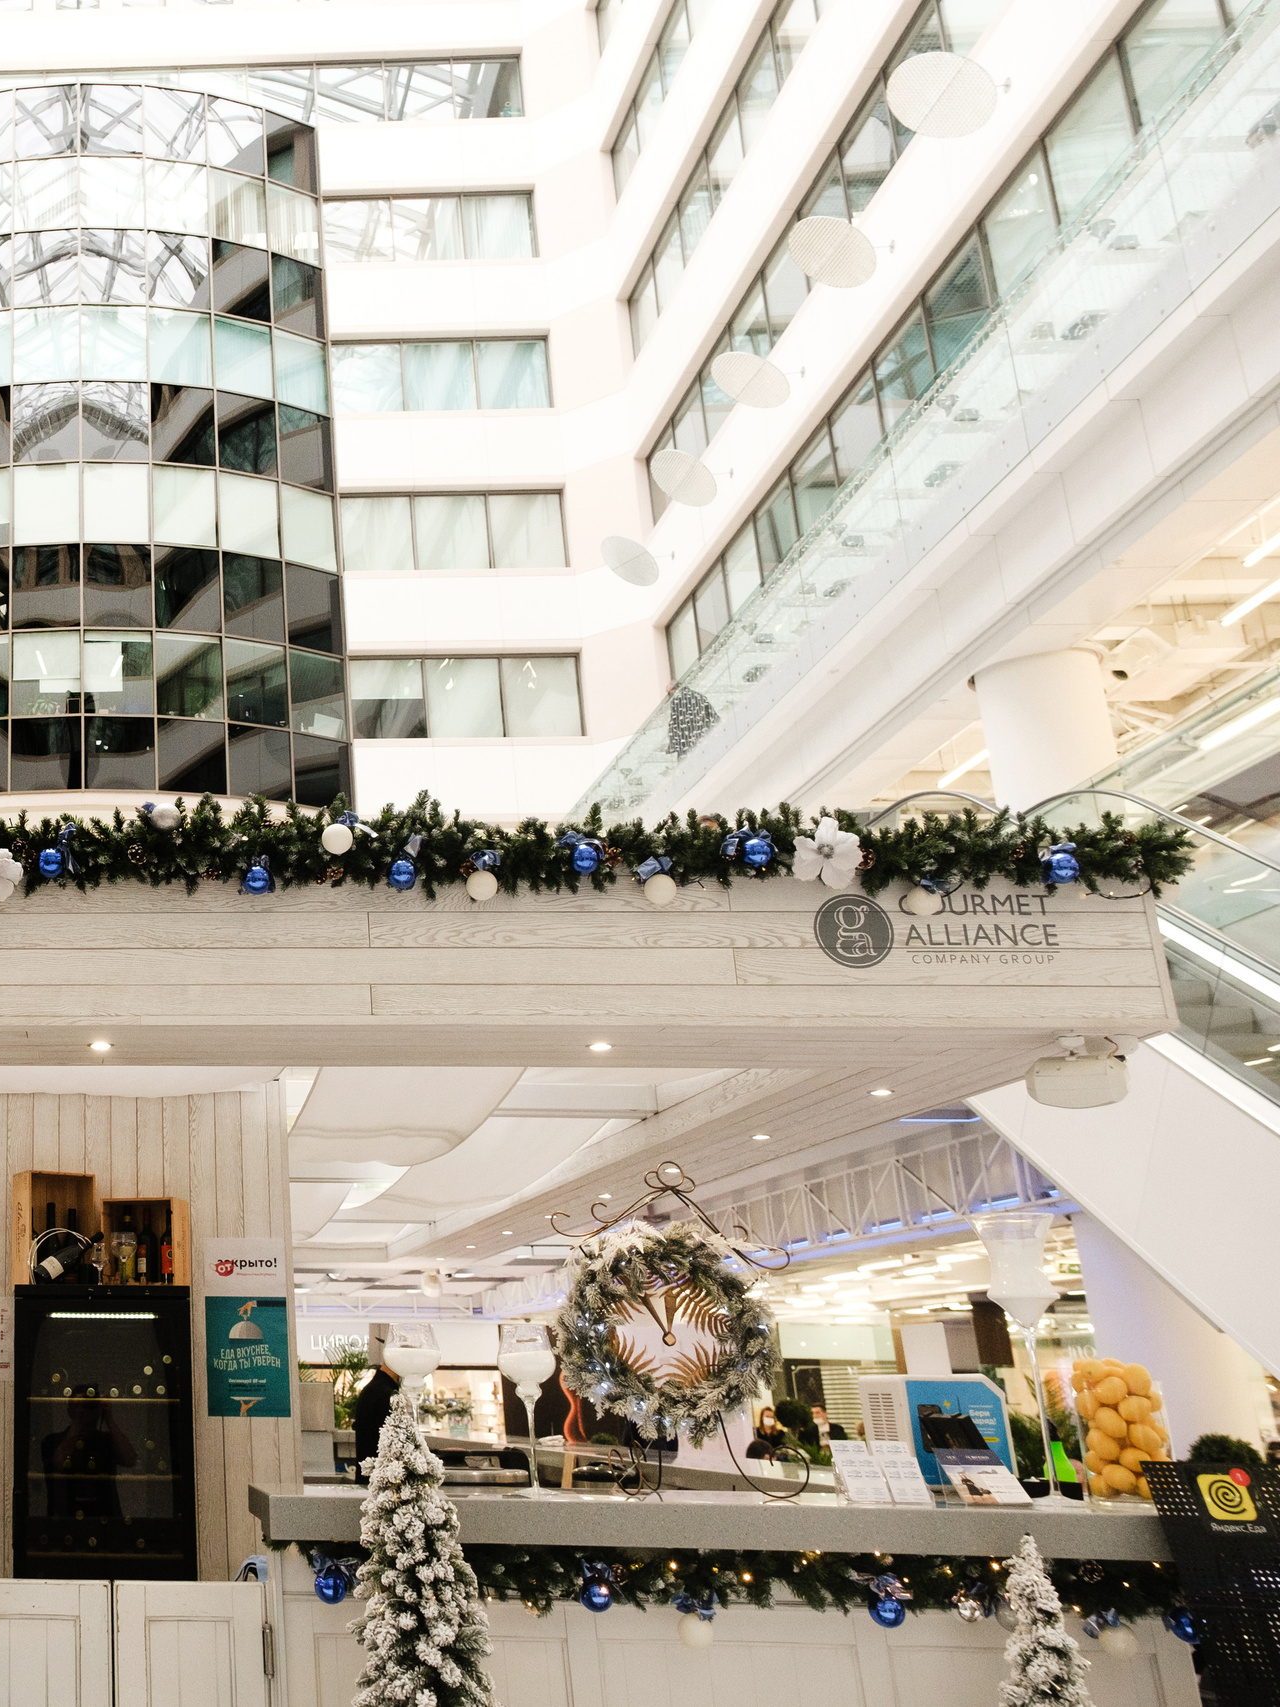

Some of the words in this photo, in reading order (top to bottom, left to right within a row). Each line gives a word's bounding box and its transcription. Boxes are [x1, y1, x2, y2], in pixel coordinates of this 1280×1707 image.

[905, 924, 1059, 946] ALLIANCE
[911, 954, 991, 964] COMPANY
[999, 954, 1056, 965] GROUP
[220, 1348, 235, 1360] ЕДА
[236, 1344, 271, 1358] ВКУСНЕЕ,
[213, 1358, 238, 1371] КОГДА
[239, 1357, 251, 1369] ТЫ
[252, 1356, 281, 1368] УВЕРЕН
[969, 1409, 990, 1418] Бери
